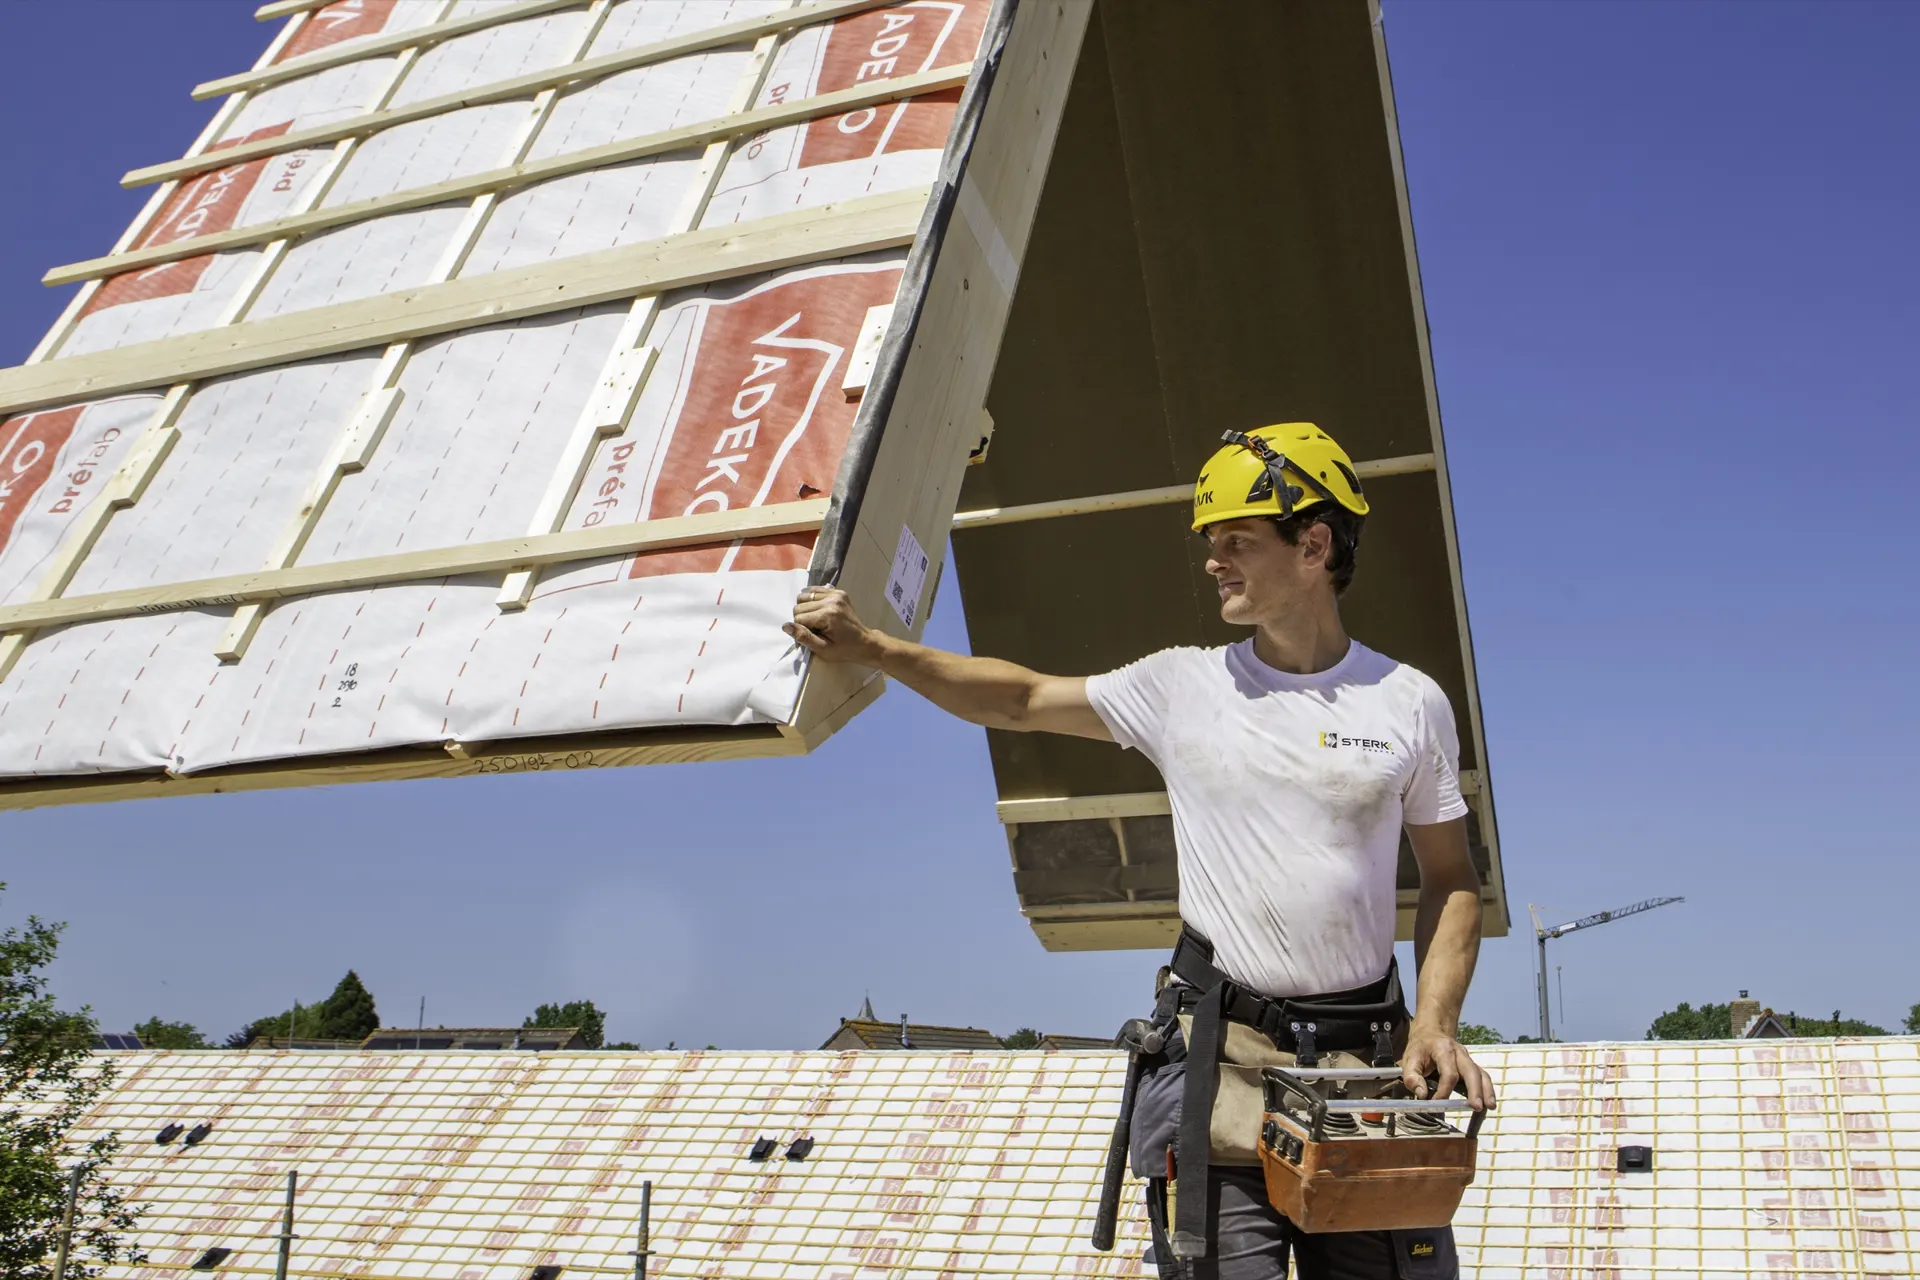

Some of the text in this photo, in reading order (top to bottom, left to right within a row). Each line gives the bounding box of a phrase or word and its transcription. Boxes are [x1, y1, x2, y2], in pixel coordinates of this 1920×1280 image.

[48, 427, 121, 513] préfab
[582, 440, 638, 529] préfa
[345, 662, 358, 677] 18
[1341, 737, 1389, 750] STERK
